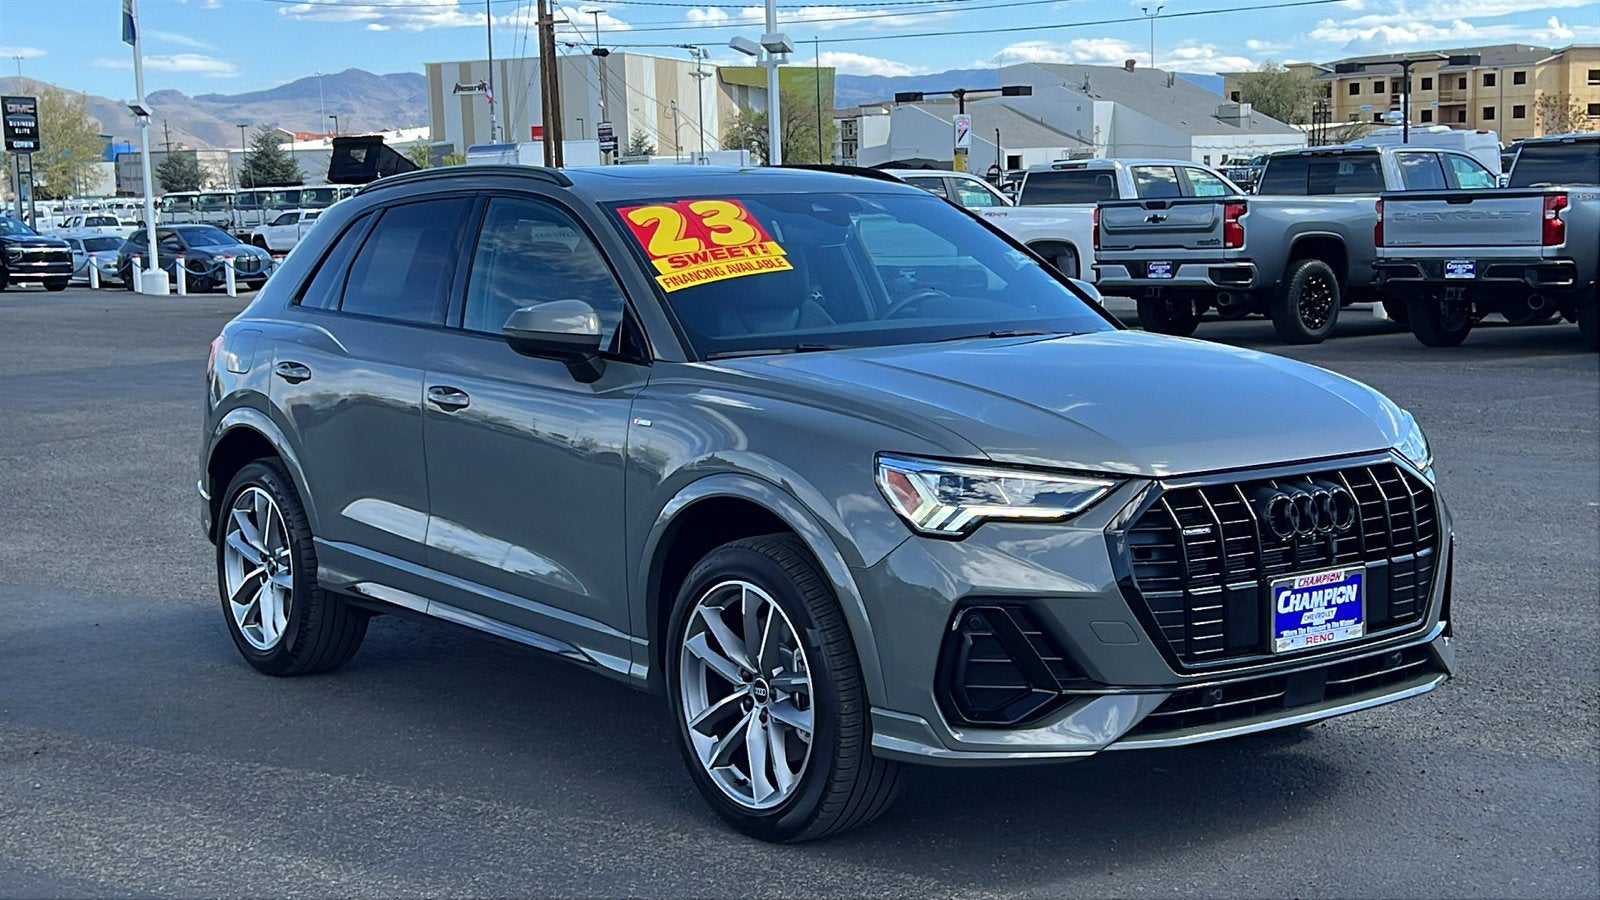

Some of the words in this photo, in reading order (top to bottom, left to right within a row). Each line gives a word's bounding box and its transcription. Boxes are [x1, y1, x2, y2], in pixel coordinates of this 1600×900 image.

[7, 104, 35, 113] GMC
[1393, 210, 1533, 222] CHEVROLET
[627, 200, 762, 257] 23
[667, 244, 769, 268] SWEET!
[662, 267, 725, 288] FINANCING
[728, 257, 787, 275] AVAILABLE
[1299, 573, 1341, 586] CHAMPION
[1277, 584, 1358, 614] CHAMPION
[1306, 633, 1334, 644] RENO
